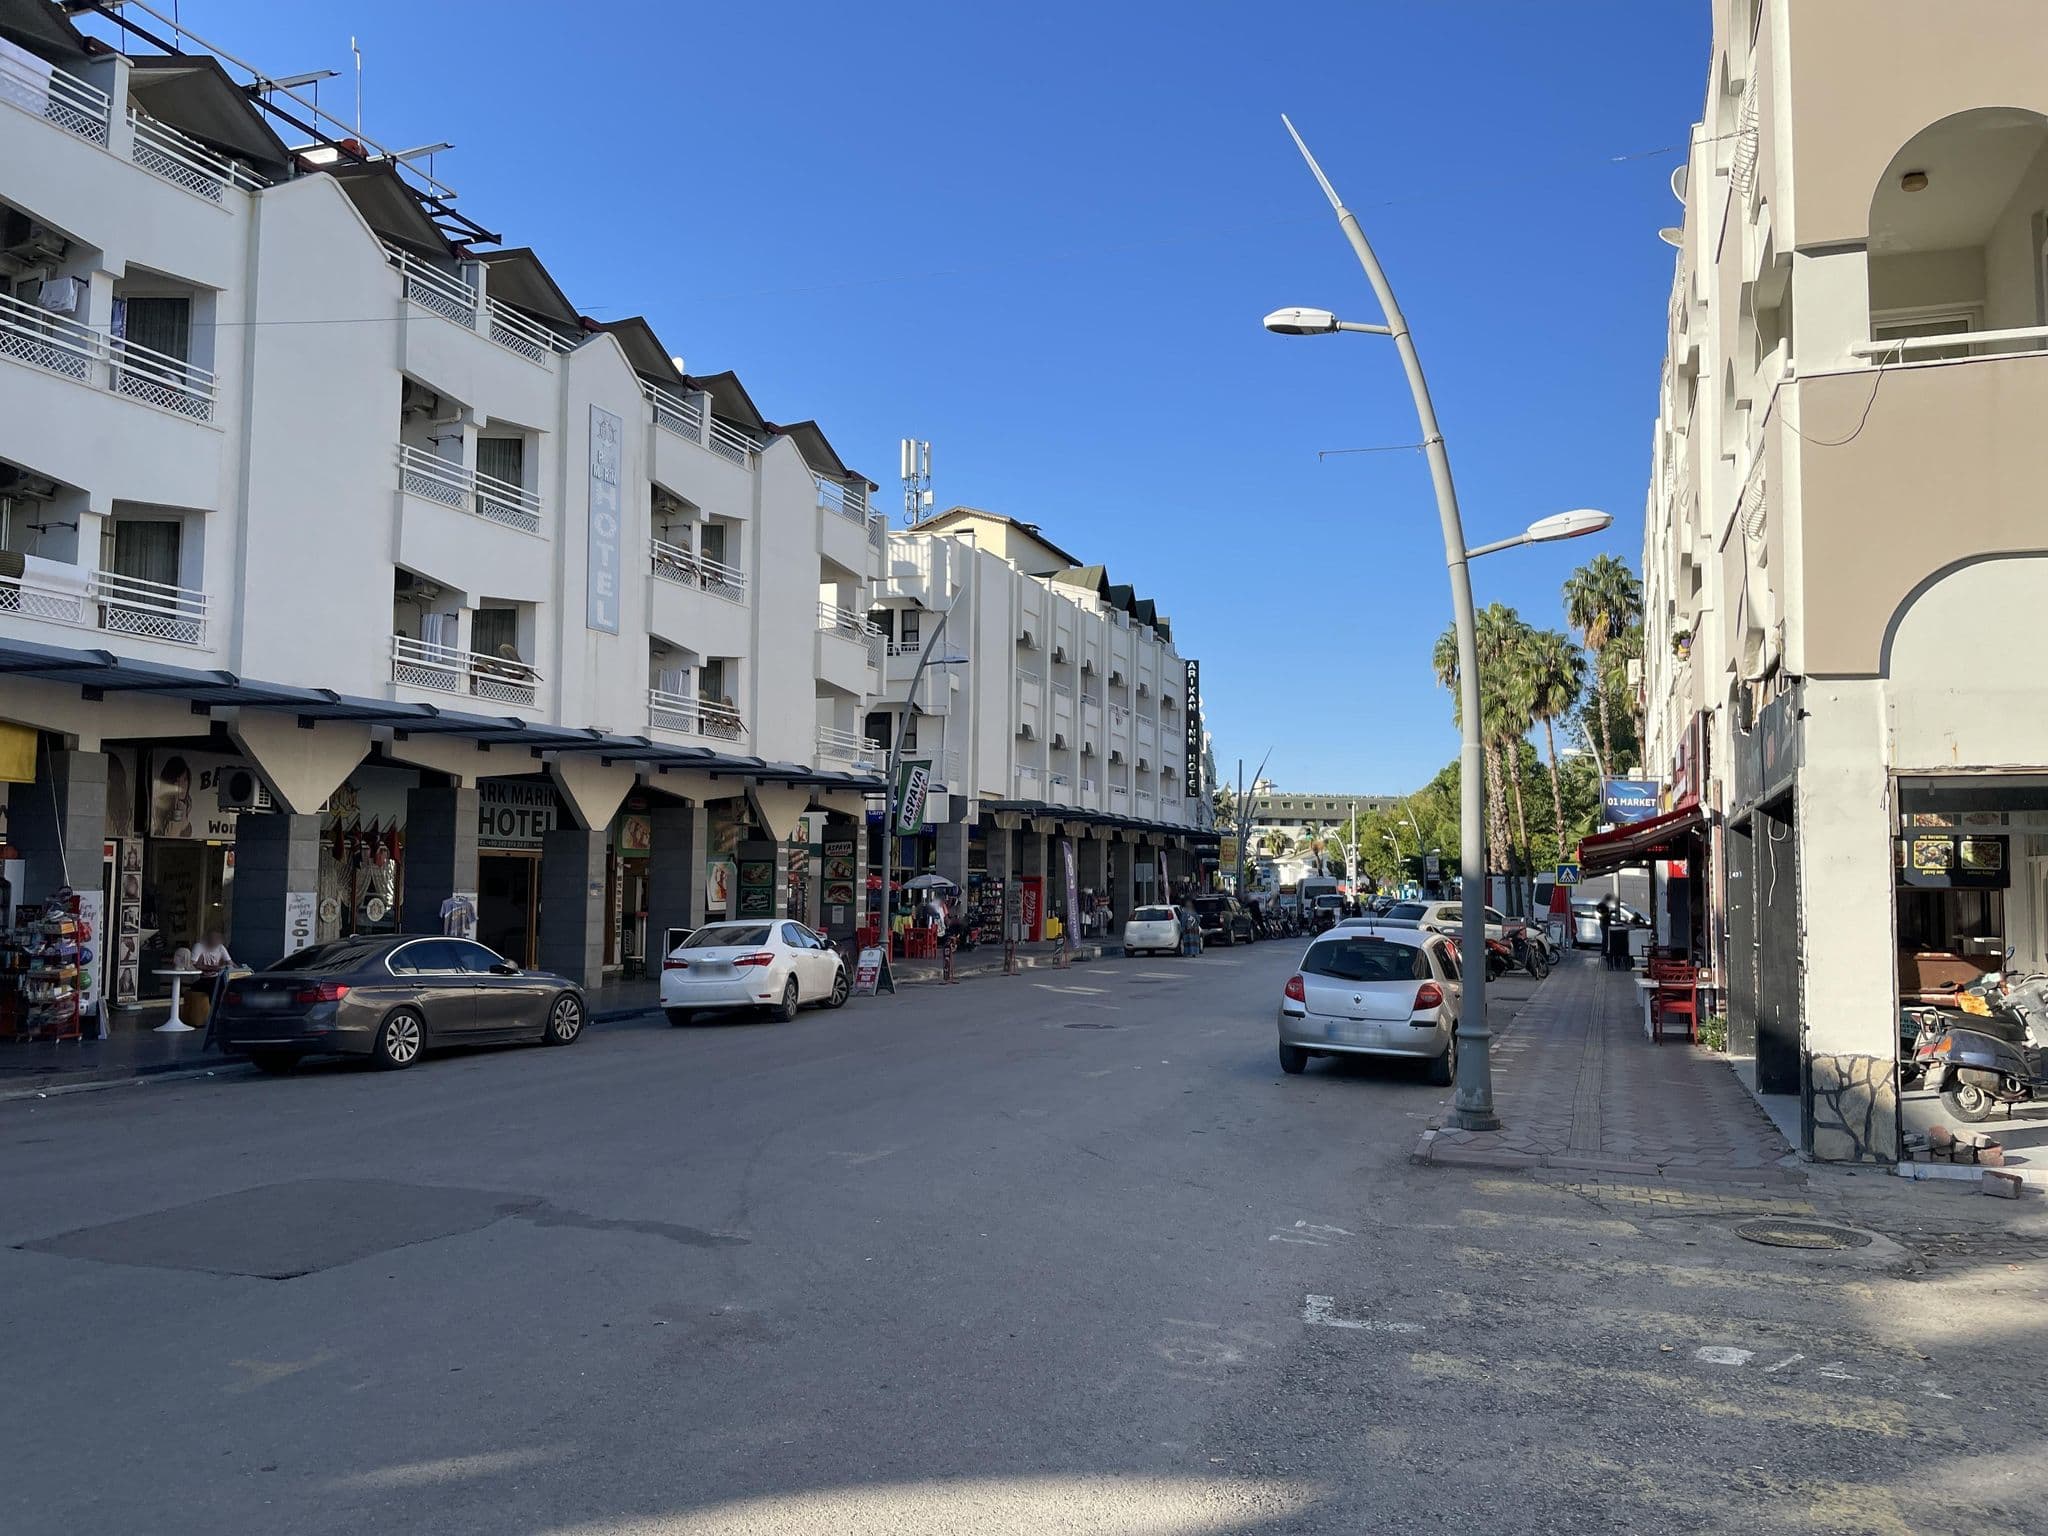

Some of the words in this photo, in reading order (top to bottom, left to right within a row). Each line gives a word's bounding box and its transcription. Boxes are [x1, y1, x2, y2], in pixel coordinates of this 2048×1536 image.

[594, 485, 617, 627] HOTEL
[1187, 661, 1197, 711] ARIKAN
[1187, 720, 1197, 745] INN
[480, 781, 506, 803] ARK
[1187, 754, 1197, 797] HOTEL
[903, 769, 924, 827] ASPAVA
[1607, 797, 1618, 806] 01
[1620, 797, 1656, 807] MARKET
[479, 806, 552, 837] HOTEL
